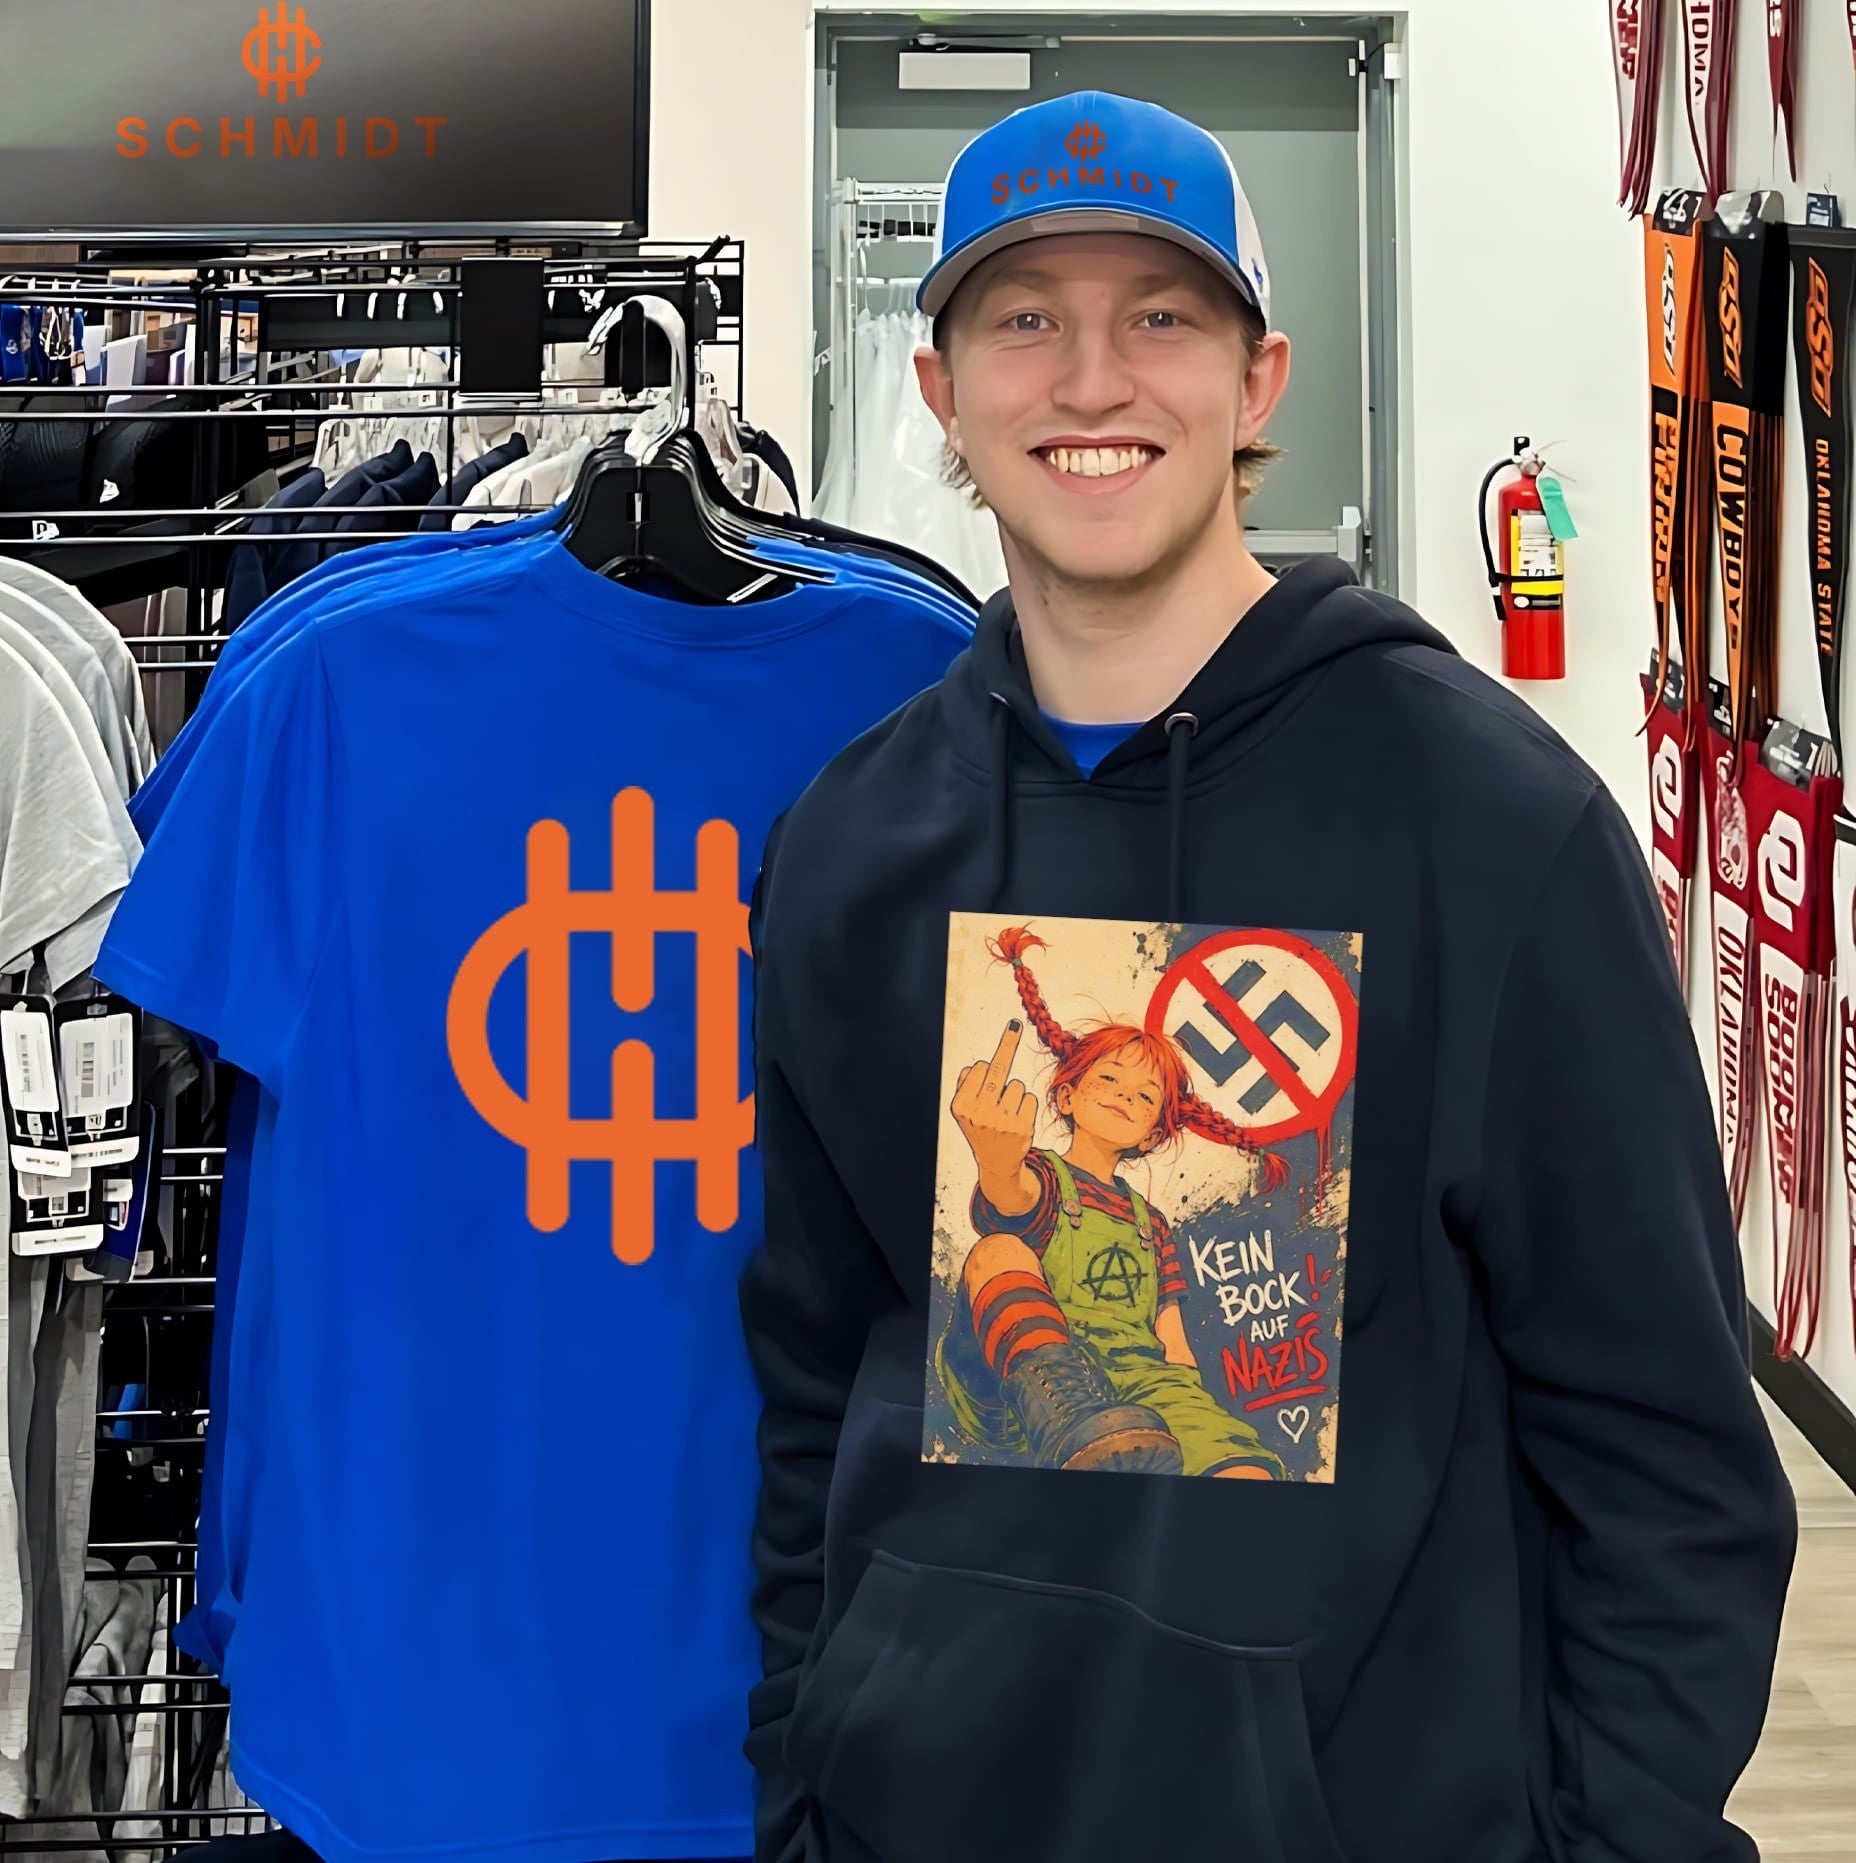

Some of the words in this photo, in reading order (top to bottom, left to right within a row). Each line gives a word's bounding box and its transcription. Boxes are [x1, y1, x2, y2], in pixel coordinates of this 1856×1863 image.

[115, 116, 448, 158] SCHMIDT
[991, 167, 1179, 205] SCHMIDT
[1815, 438, 1832, 570] OKLAHOMA
[1188, 1229, 1275, 1287] KEIN
[1250, 1314, 1289, 1343] AUF
[1222, 1327, 1329, 1401] NAZIS
